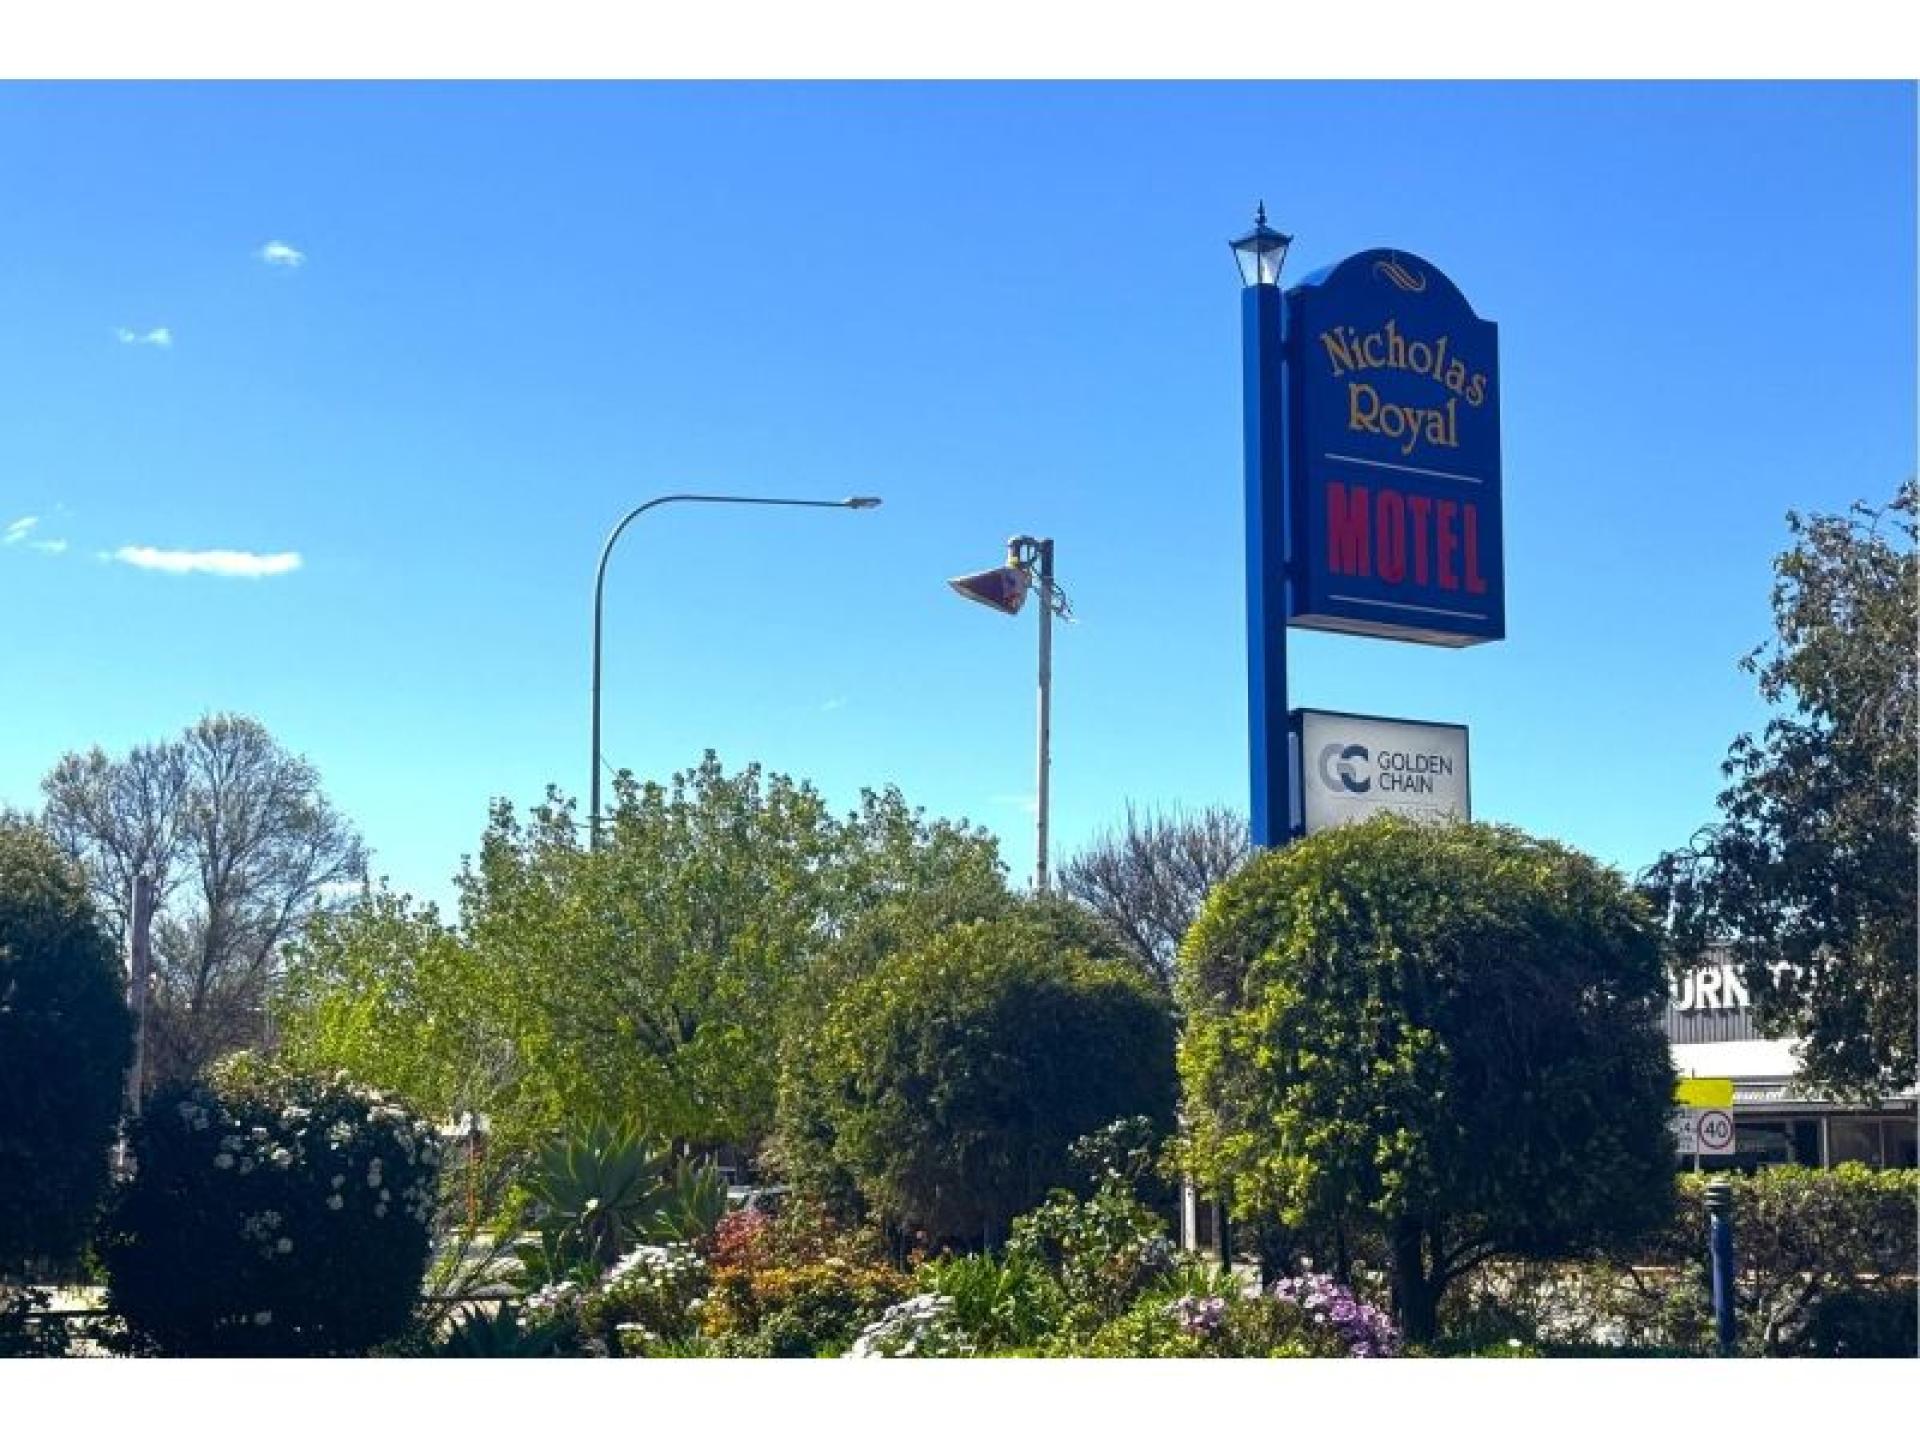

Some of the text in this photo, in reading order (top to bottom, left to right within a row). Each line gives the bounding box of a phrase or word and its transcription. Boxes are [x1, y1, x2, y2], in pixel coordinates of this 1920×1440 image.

[1320, 319, 1487, 406] Nicholas
[1348, 383, 1459, 455] Royal
[1326, 481, 1487, 594] MOTEL
[1377, 750, 1453, 775] GOLDEN
[1379, 772, 1434, 793] CHAIN
[1704, 1120, 1727, 1138] 40
